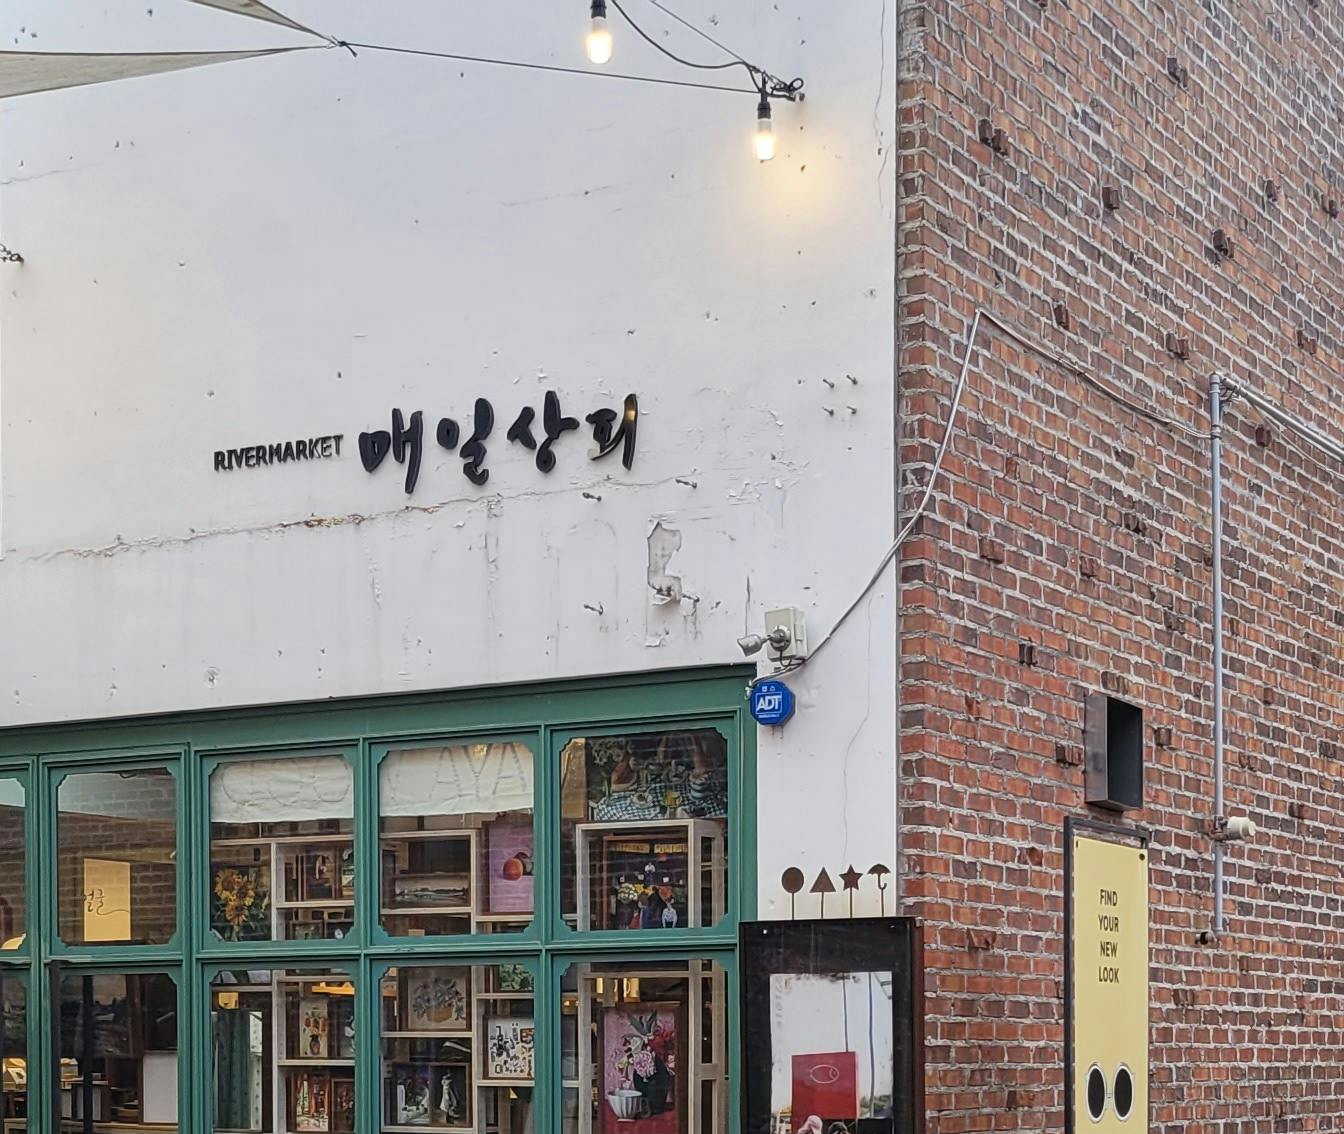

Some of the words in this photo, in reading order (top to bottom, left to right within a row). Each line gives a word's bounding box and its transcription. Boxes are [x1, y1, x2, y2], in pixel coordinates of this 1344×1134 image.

[357, 390, 639, 495] 매일상회
[213, 434, 344, 472] RIVERMARKET
[756, 695, 782, 711] ADT
[1099, 888, 1118, 907] FIND
[1098, 914, 1119, 933] YOUR
[1099, 941, 1118, 958] NEW
[1098, 966, 1120, 984] LOOK
